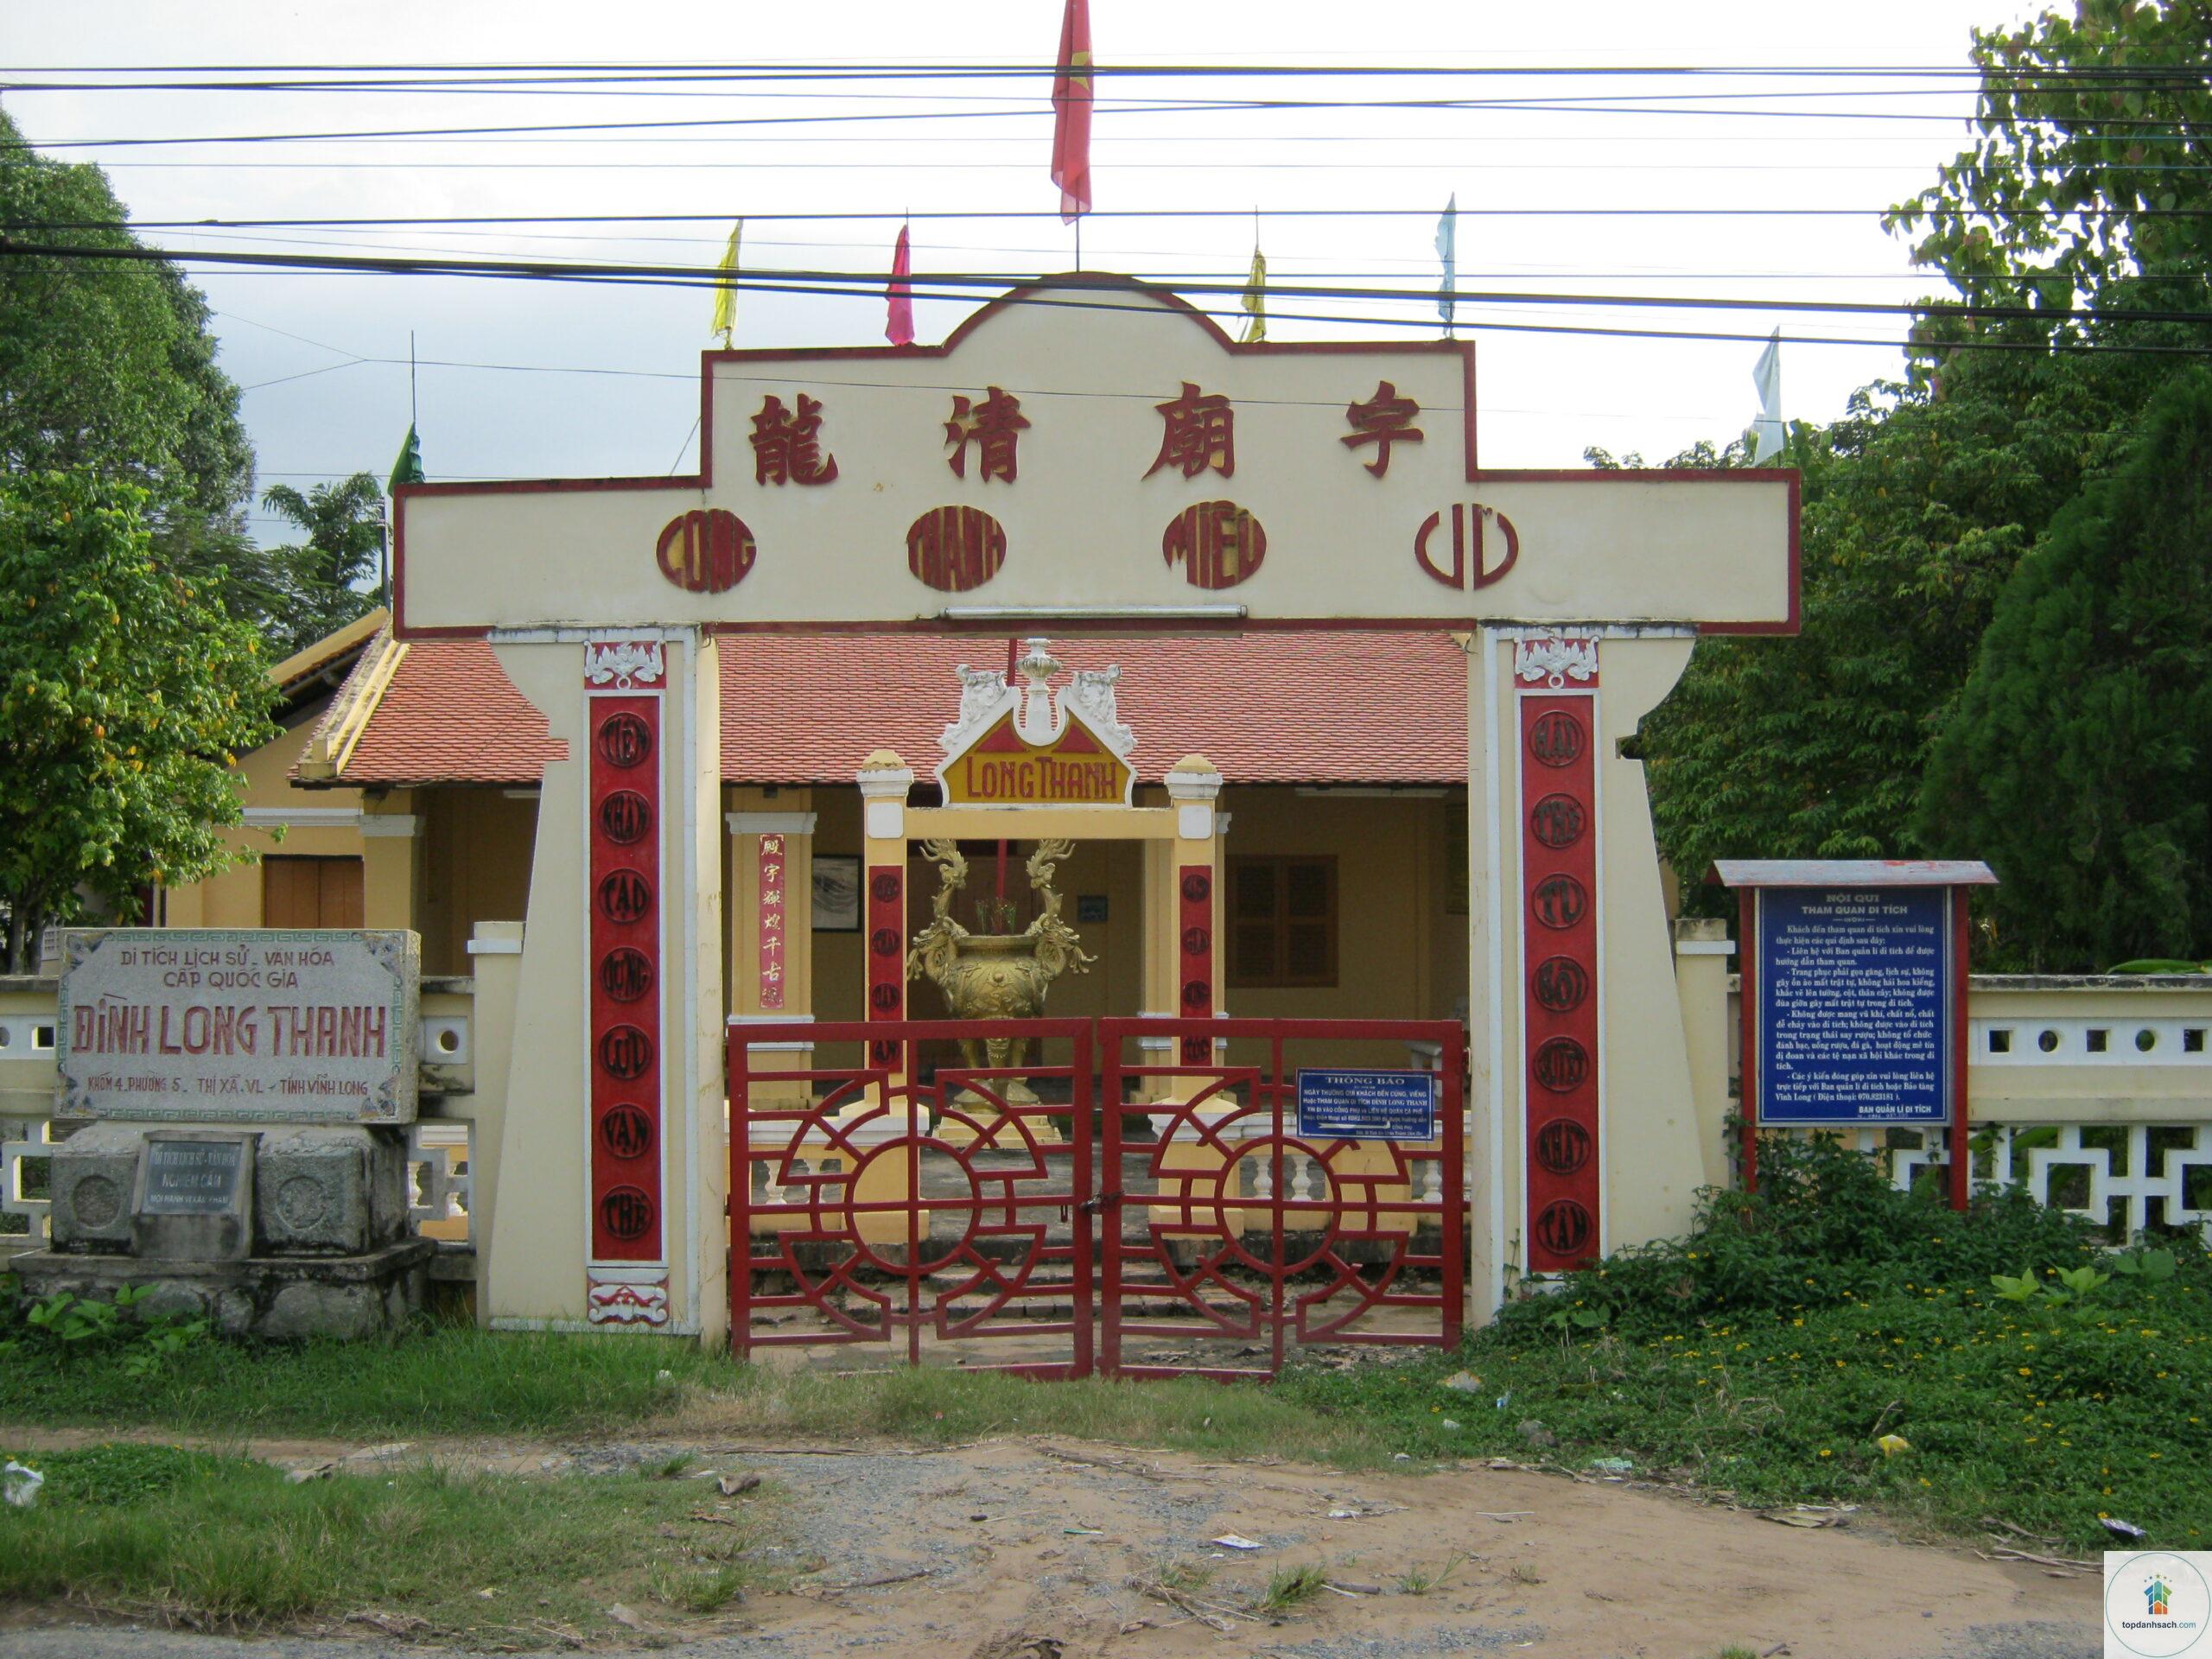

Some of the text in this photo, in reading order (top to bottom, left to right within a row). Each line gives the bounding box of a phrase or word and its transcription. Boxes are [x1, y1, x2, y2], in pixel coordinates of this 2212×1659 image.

[966, 756, 1117, 799] LONG THANH
[1802, 906, 1833, 914] THAM
[1882, 905, 1908, 914] TÍCH
[121, 948, 137, 965] DI
[142, 945, 177, 965] TÍCH
[184, 948, 219, 969] LỊCH
[226, 944, 251, 966] SỬ
[299, 946, 335, 966] HÓA
[163, 967, 299, 990] CẤP QUỐC GIA
[72, 993, 386, 1058] ĐÌNH LONG THANH
[172, 1077, 181, 1092] 5
[197, 1075, 216, 1096] THỊ
[339, 1080, 368, 1096] LONG
[1325, 1076, 1405, 1086] THÔNG BÁO
[1875, 1103, 1896, 1115] QUẢN
[1897, 1105, 1904, 1114] LÍ
[1914, 1104, 1931, 1113] TÍCH
